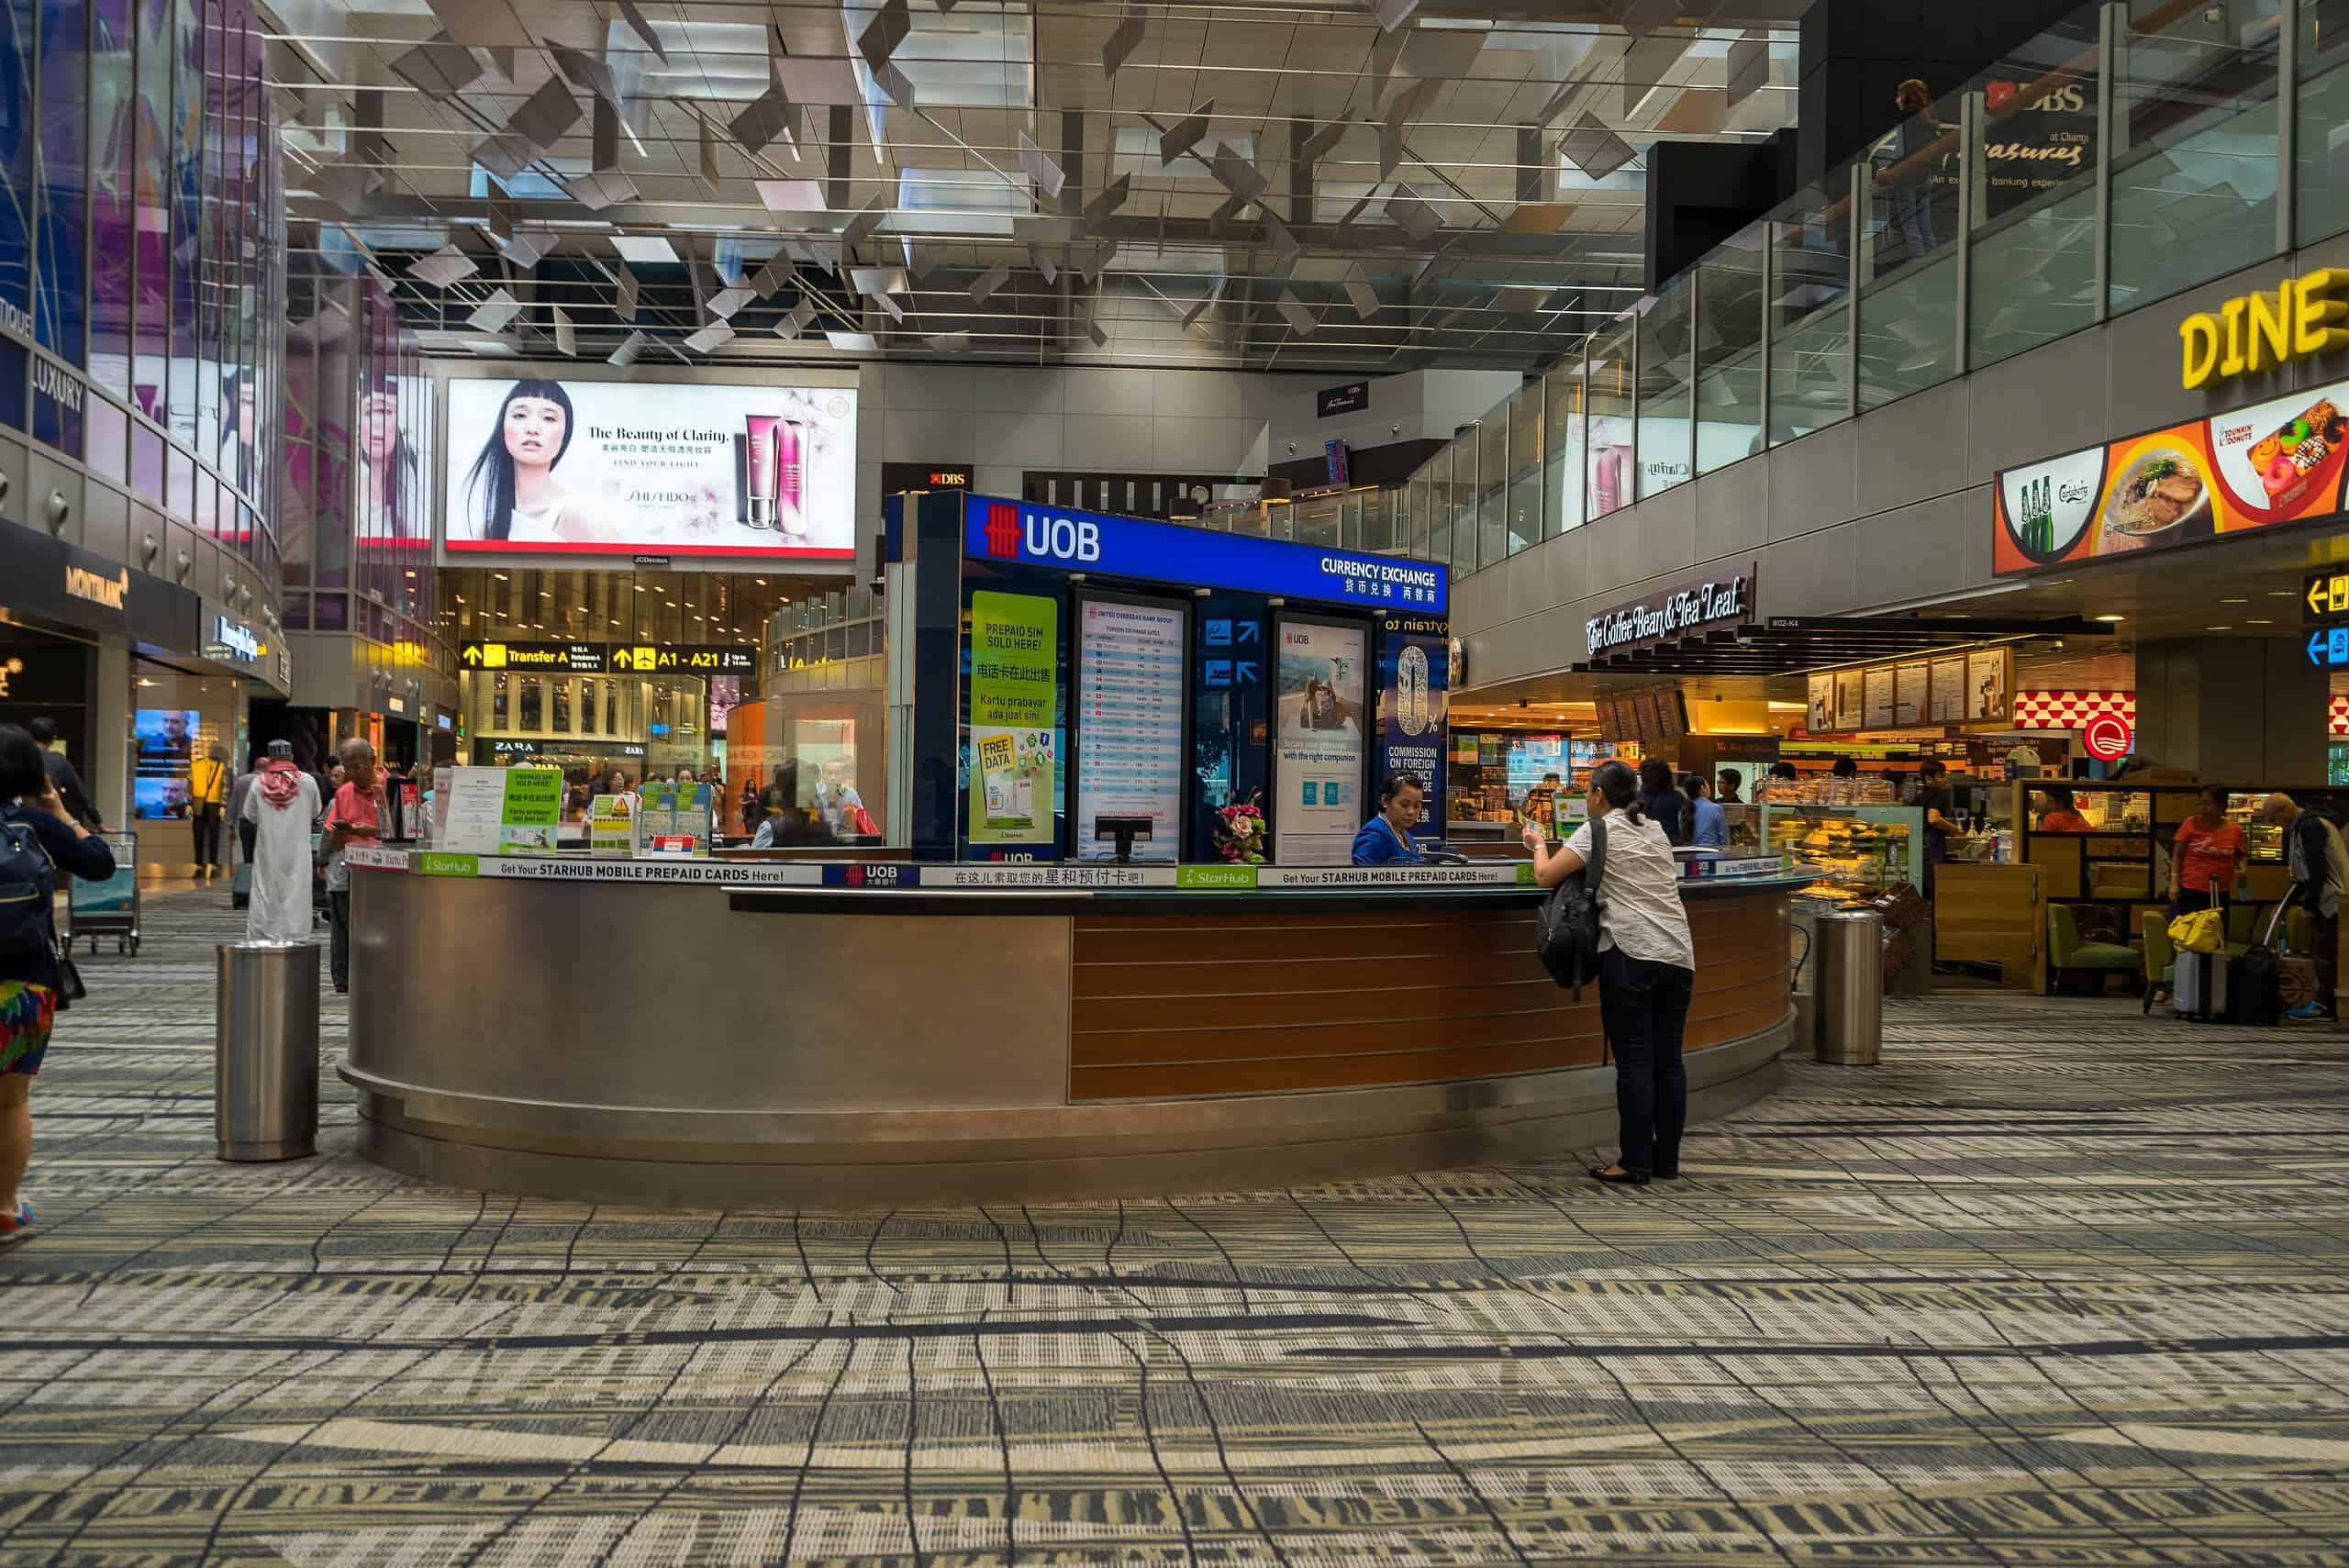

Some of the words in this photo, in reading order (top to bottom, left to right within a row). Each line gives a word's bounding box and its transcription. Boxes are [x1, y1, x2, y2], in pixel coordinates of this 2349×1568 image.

[2050, 133, 2059, 141] at
[1992, 176, 2028, 187] banking
[2179, 267, 2338, 390] DINE
[588, 427, 612, 439] The
[617, 428, 662, 442] Beauty
[666, 430, 678, 440] of
[683, 430, 729, 444] Clarity.
[2227, 433, 2252, 444] DONUTS
[941, 473, 964, 484] DBS
[629, 490, 688, 502] SHISEIDO
[2059, 484, 2088, 503] Carlsberg
[1026, 514, 1100, 562] UOB
[1321, 558, 1379, 579] CURRENCY
[1382, 567, 1436, 587] EXCHANGE
[1603, 611, 1632, 646] Coffee
[1633, 606, 1664, 638] Bean
[1664, 596, 1675, 630] &
[1676, 591, 1699, 627] Tea
[986, 624, 1025, 638] PREPAID
[1028, 627, 1043, 639] SIM
[987, 637, 1011, 648] SOLD
[1014, 639, 1041, 651] HERE!
[1293, 633, 1308, 644] UOB
[508, 651, 555, 662] Transfer
[558, 651, 568, 662] A
[658, 652, 677, 666] A1
[691, 652, 718, 667] A21
[978, 663, 1051, 684] 电话卡在此出售
[981, 693, 1006, 706] Kartu
[1008, 695, 1047, 710] prabayar
[987, 708, 1003, 719] ada
[1005, 709, 1021, 722] jual
[1024, 710, 1040, 720] sini
[495, 742, 535, 751] ZARA
[625, 746, 644, 755] ZARA
[984, 740, 1008, 755] FREE
[1388, 746, 1437, 758] COMMISSION
[985, 755, 1010, 770] DATA
[1324, 753, 1355, 764] companion
[1389, 758, 1401, 769] ON
[1404, 759, 1435, 770] FOREIGN
[433, 860, 471, 872] StarHub
[866, 865, 897, 877] UOB
[501, 863, 516, 873] Get
[518, 864, 538, 874] Your
[540, 864, 593, 877] STARHUB
[596, 865, 642, 878] MOBILE
[646, 867, 701, 880] PREPAID
[705, 869, 749, 881] CARDS
[752, 870, 784, 882] Here!
[1197, 872, 1249, 883] StarHub
[1283, 873, 1297, 883] Get
[1300, 873, 1319, 883] Your
[1321, 873, 1368, 883] STARHUB
[1371, 873, 1406, 882] MOBILE
[1408, 872, 1447, 881] PREPAID
[1449, 872, 1476, 881] CARDS
[1478, 873, 1497, 881] Here!
